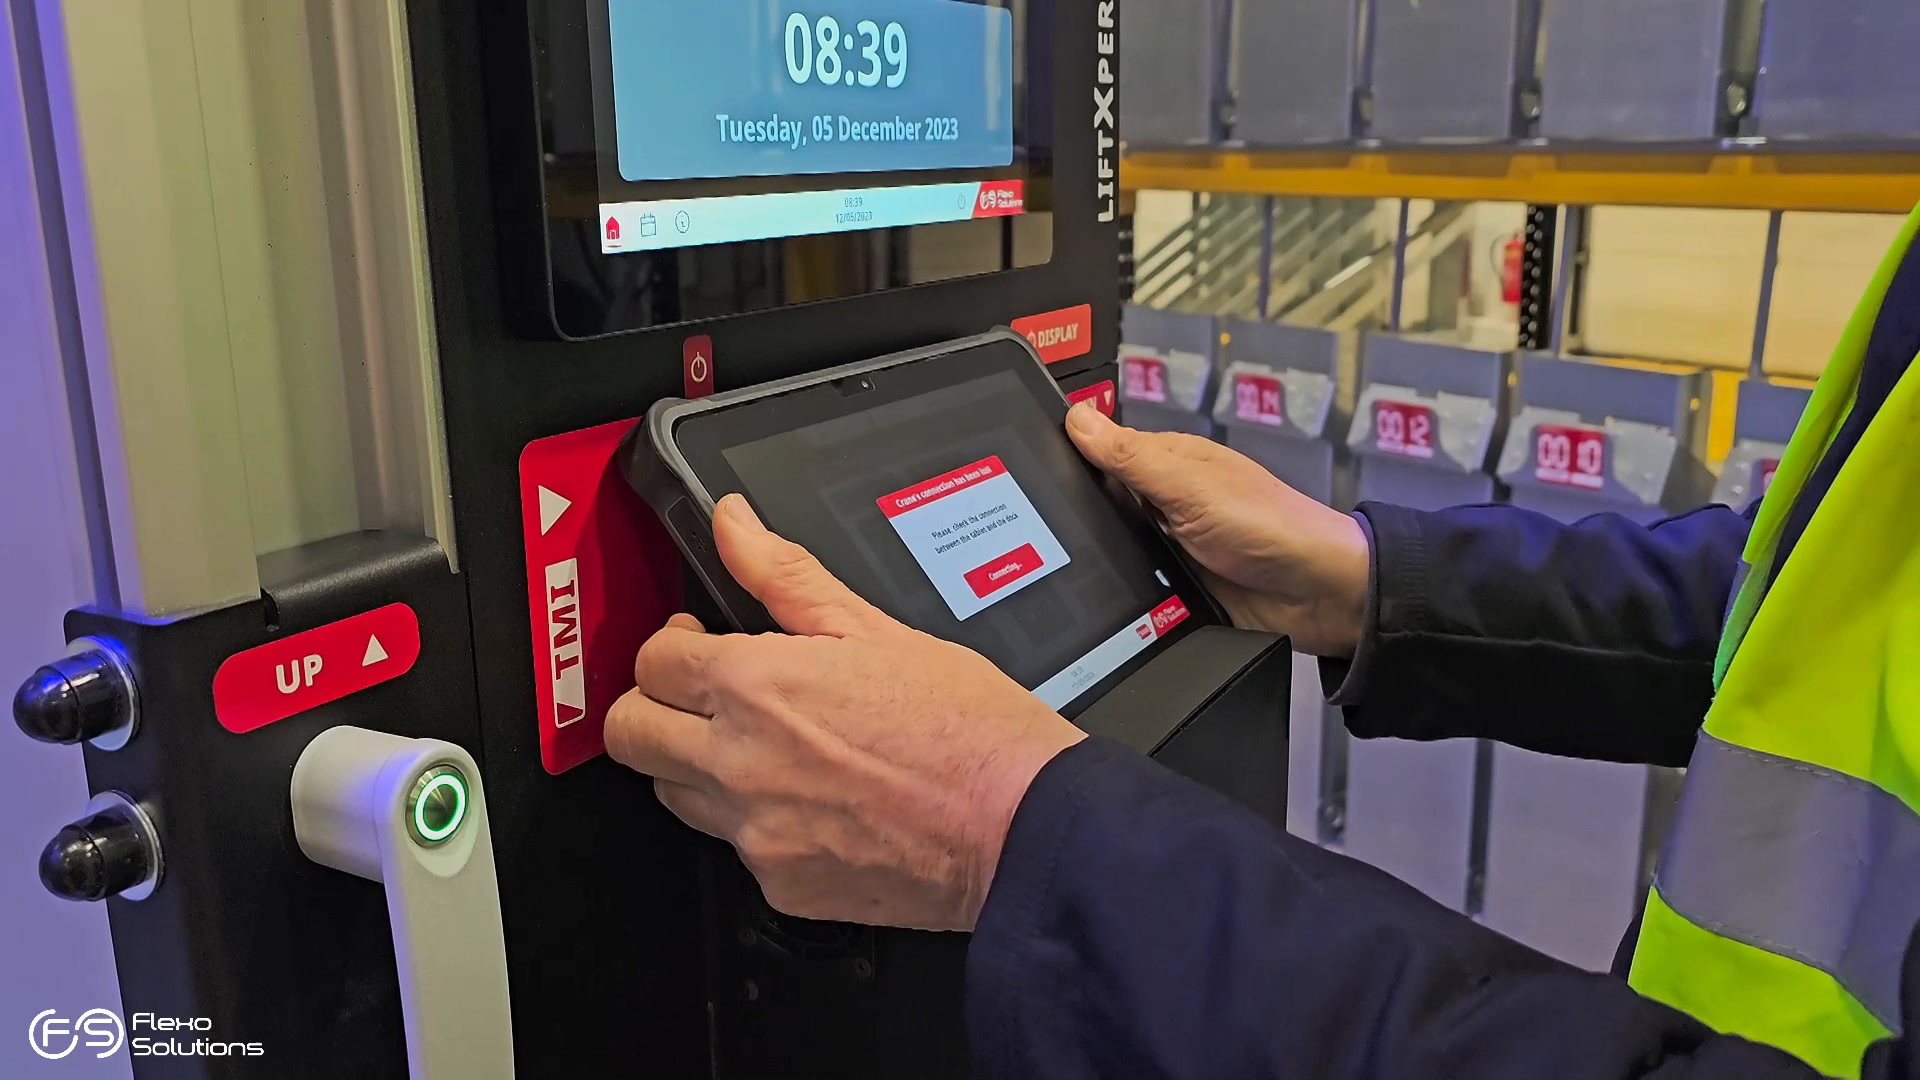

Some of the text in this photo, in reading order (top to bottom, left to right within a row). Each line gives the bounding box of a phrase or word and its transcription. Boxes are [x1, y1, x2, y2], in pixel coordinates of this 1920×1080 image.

[784, 12, 908, 88] 08:39
[716, 113, 959, 150] Tuesday, 05 December 2023
[844, 197, 863, 208] 08:39
[1038, 323, 1078, 348] DISPLAY
[550, 579, 580, 680] TMI
[275, 654, 323, 694] UP
